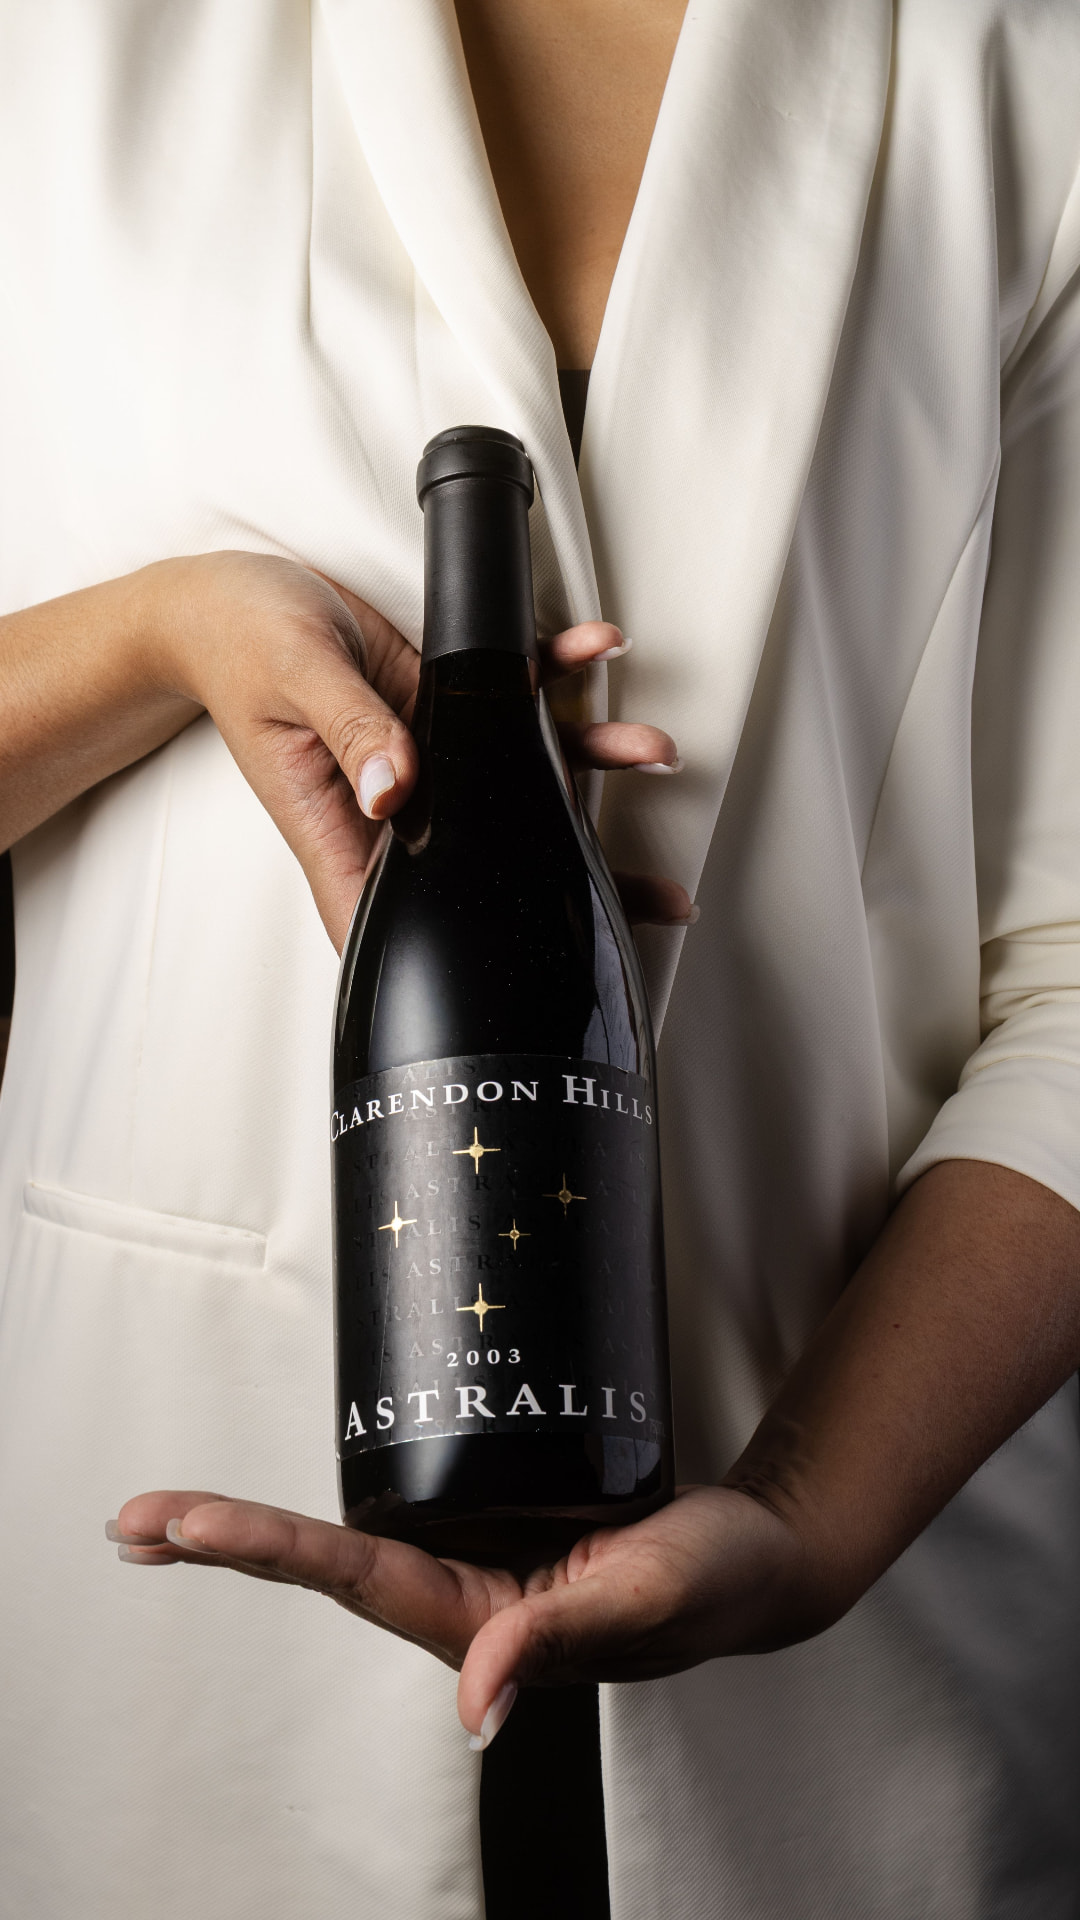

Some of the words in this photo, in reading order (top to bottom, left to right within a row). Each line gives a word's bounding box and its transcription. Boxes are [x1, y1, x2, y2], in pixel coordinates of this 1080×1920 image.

[330, 1081, 540, 1142] CLARENDON
[562, 1075, 653, 1125] HILLS
[447, 1348, 522, 1368] 2003
[344, 1383, 648, 1440] ASTRALIS
